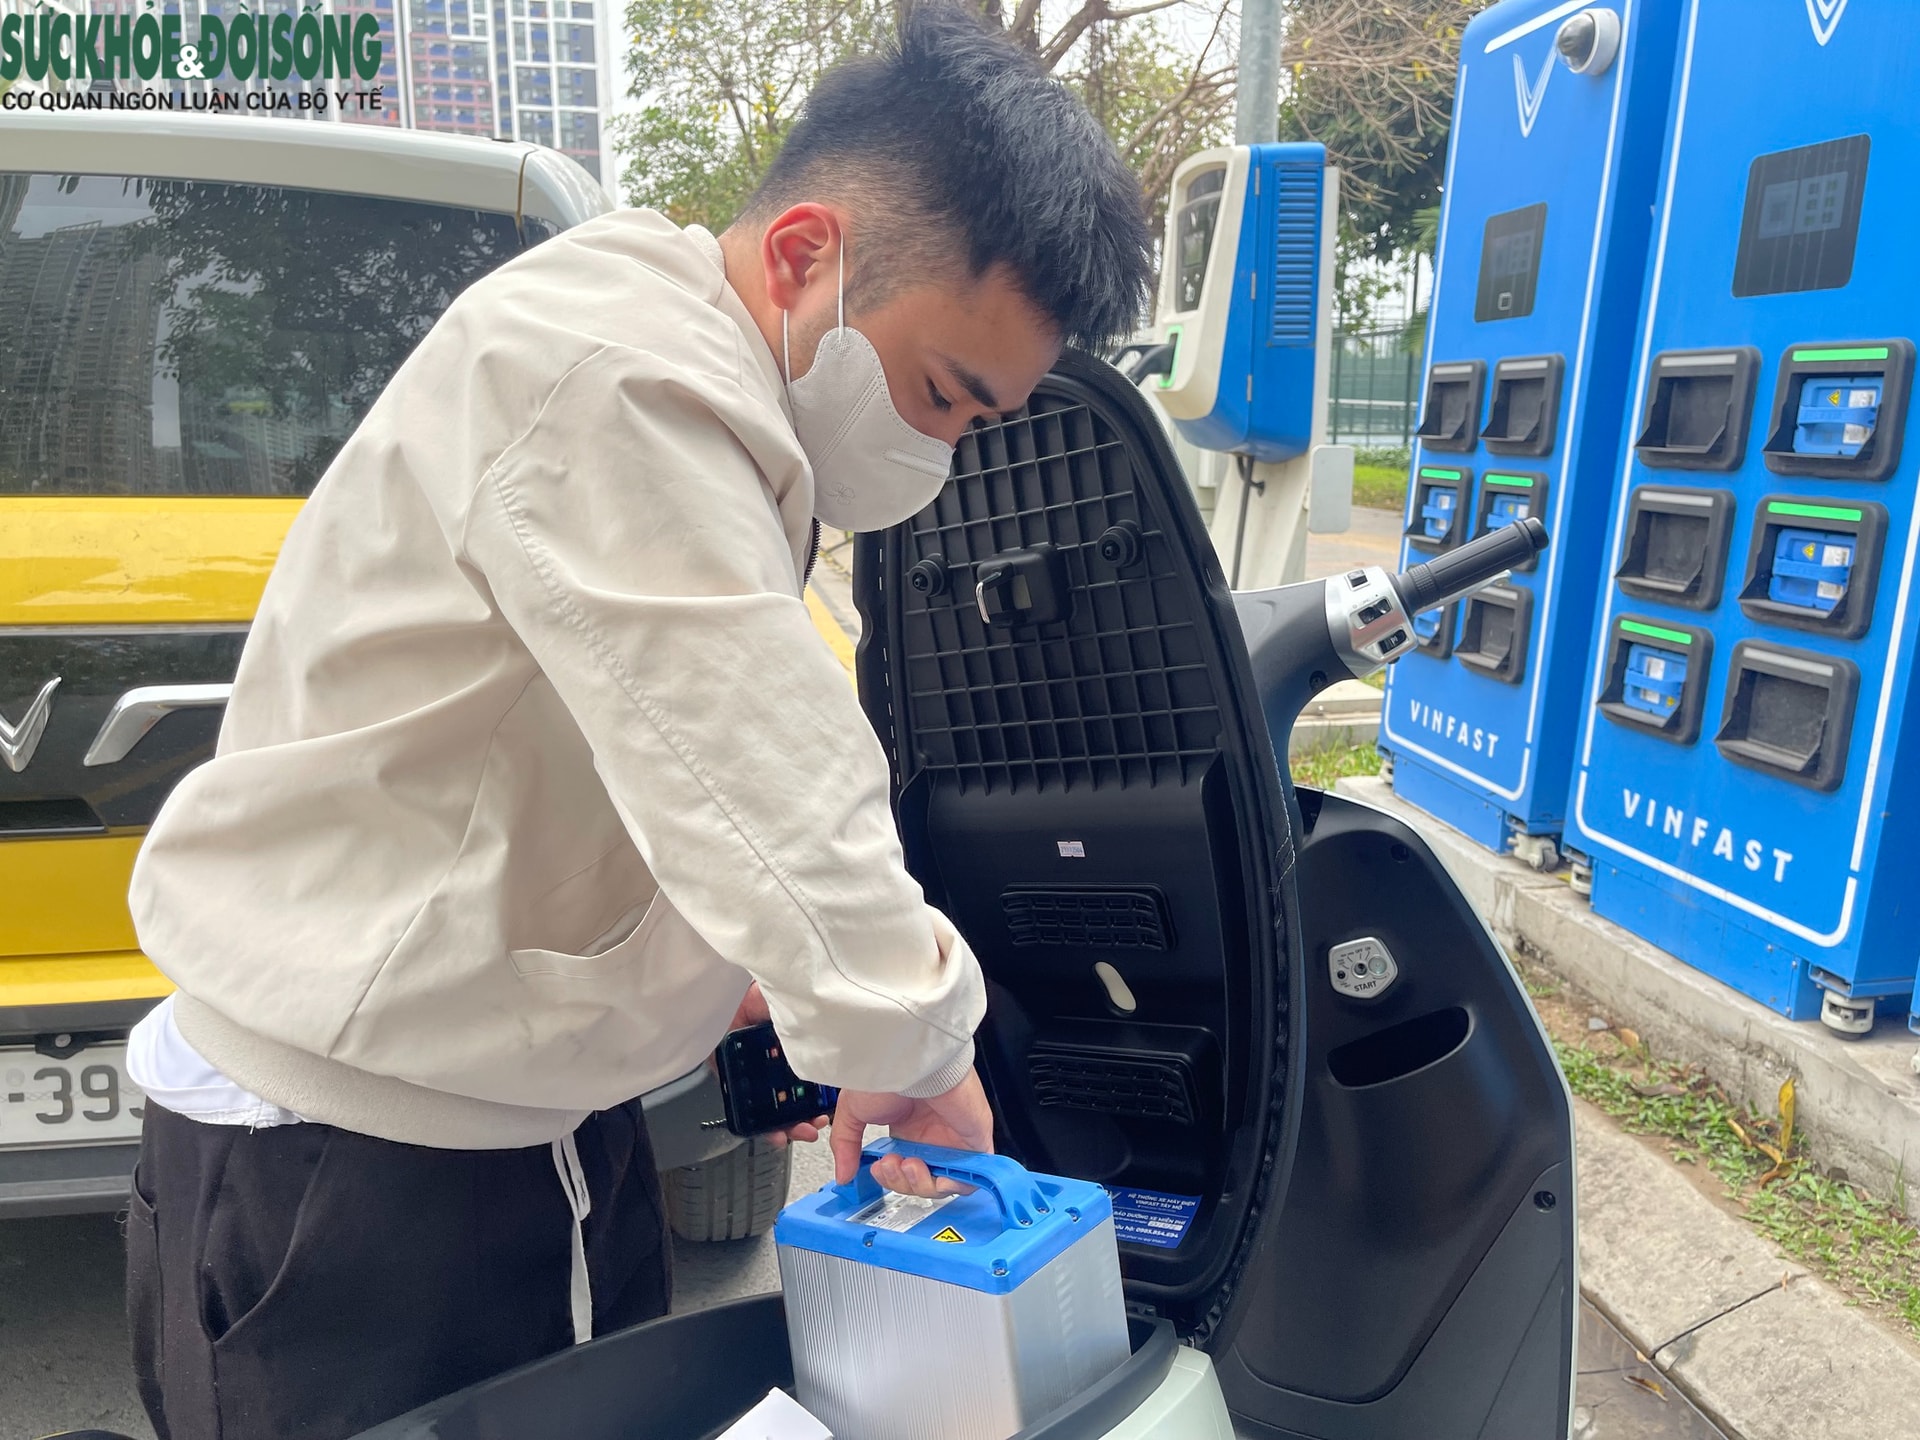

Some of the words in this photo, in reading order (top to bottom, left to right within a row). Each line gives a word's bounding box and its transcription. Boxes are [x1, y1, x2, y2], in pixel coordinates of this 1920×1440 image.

[1411, 699, 1499, 758] VINFAST
[1623, 788, 1793, 883] VINFAST
[1354, 980, 1377, 992] START
